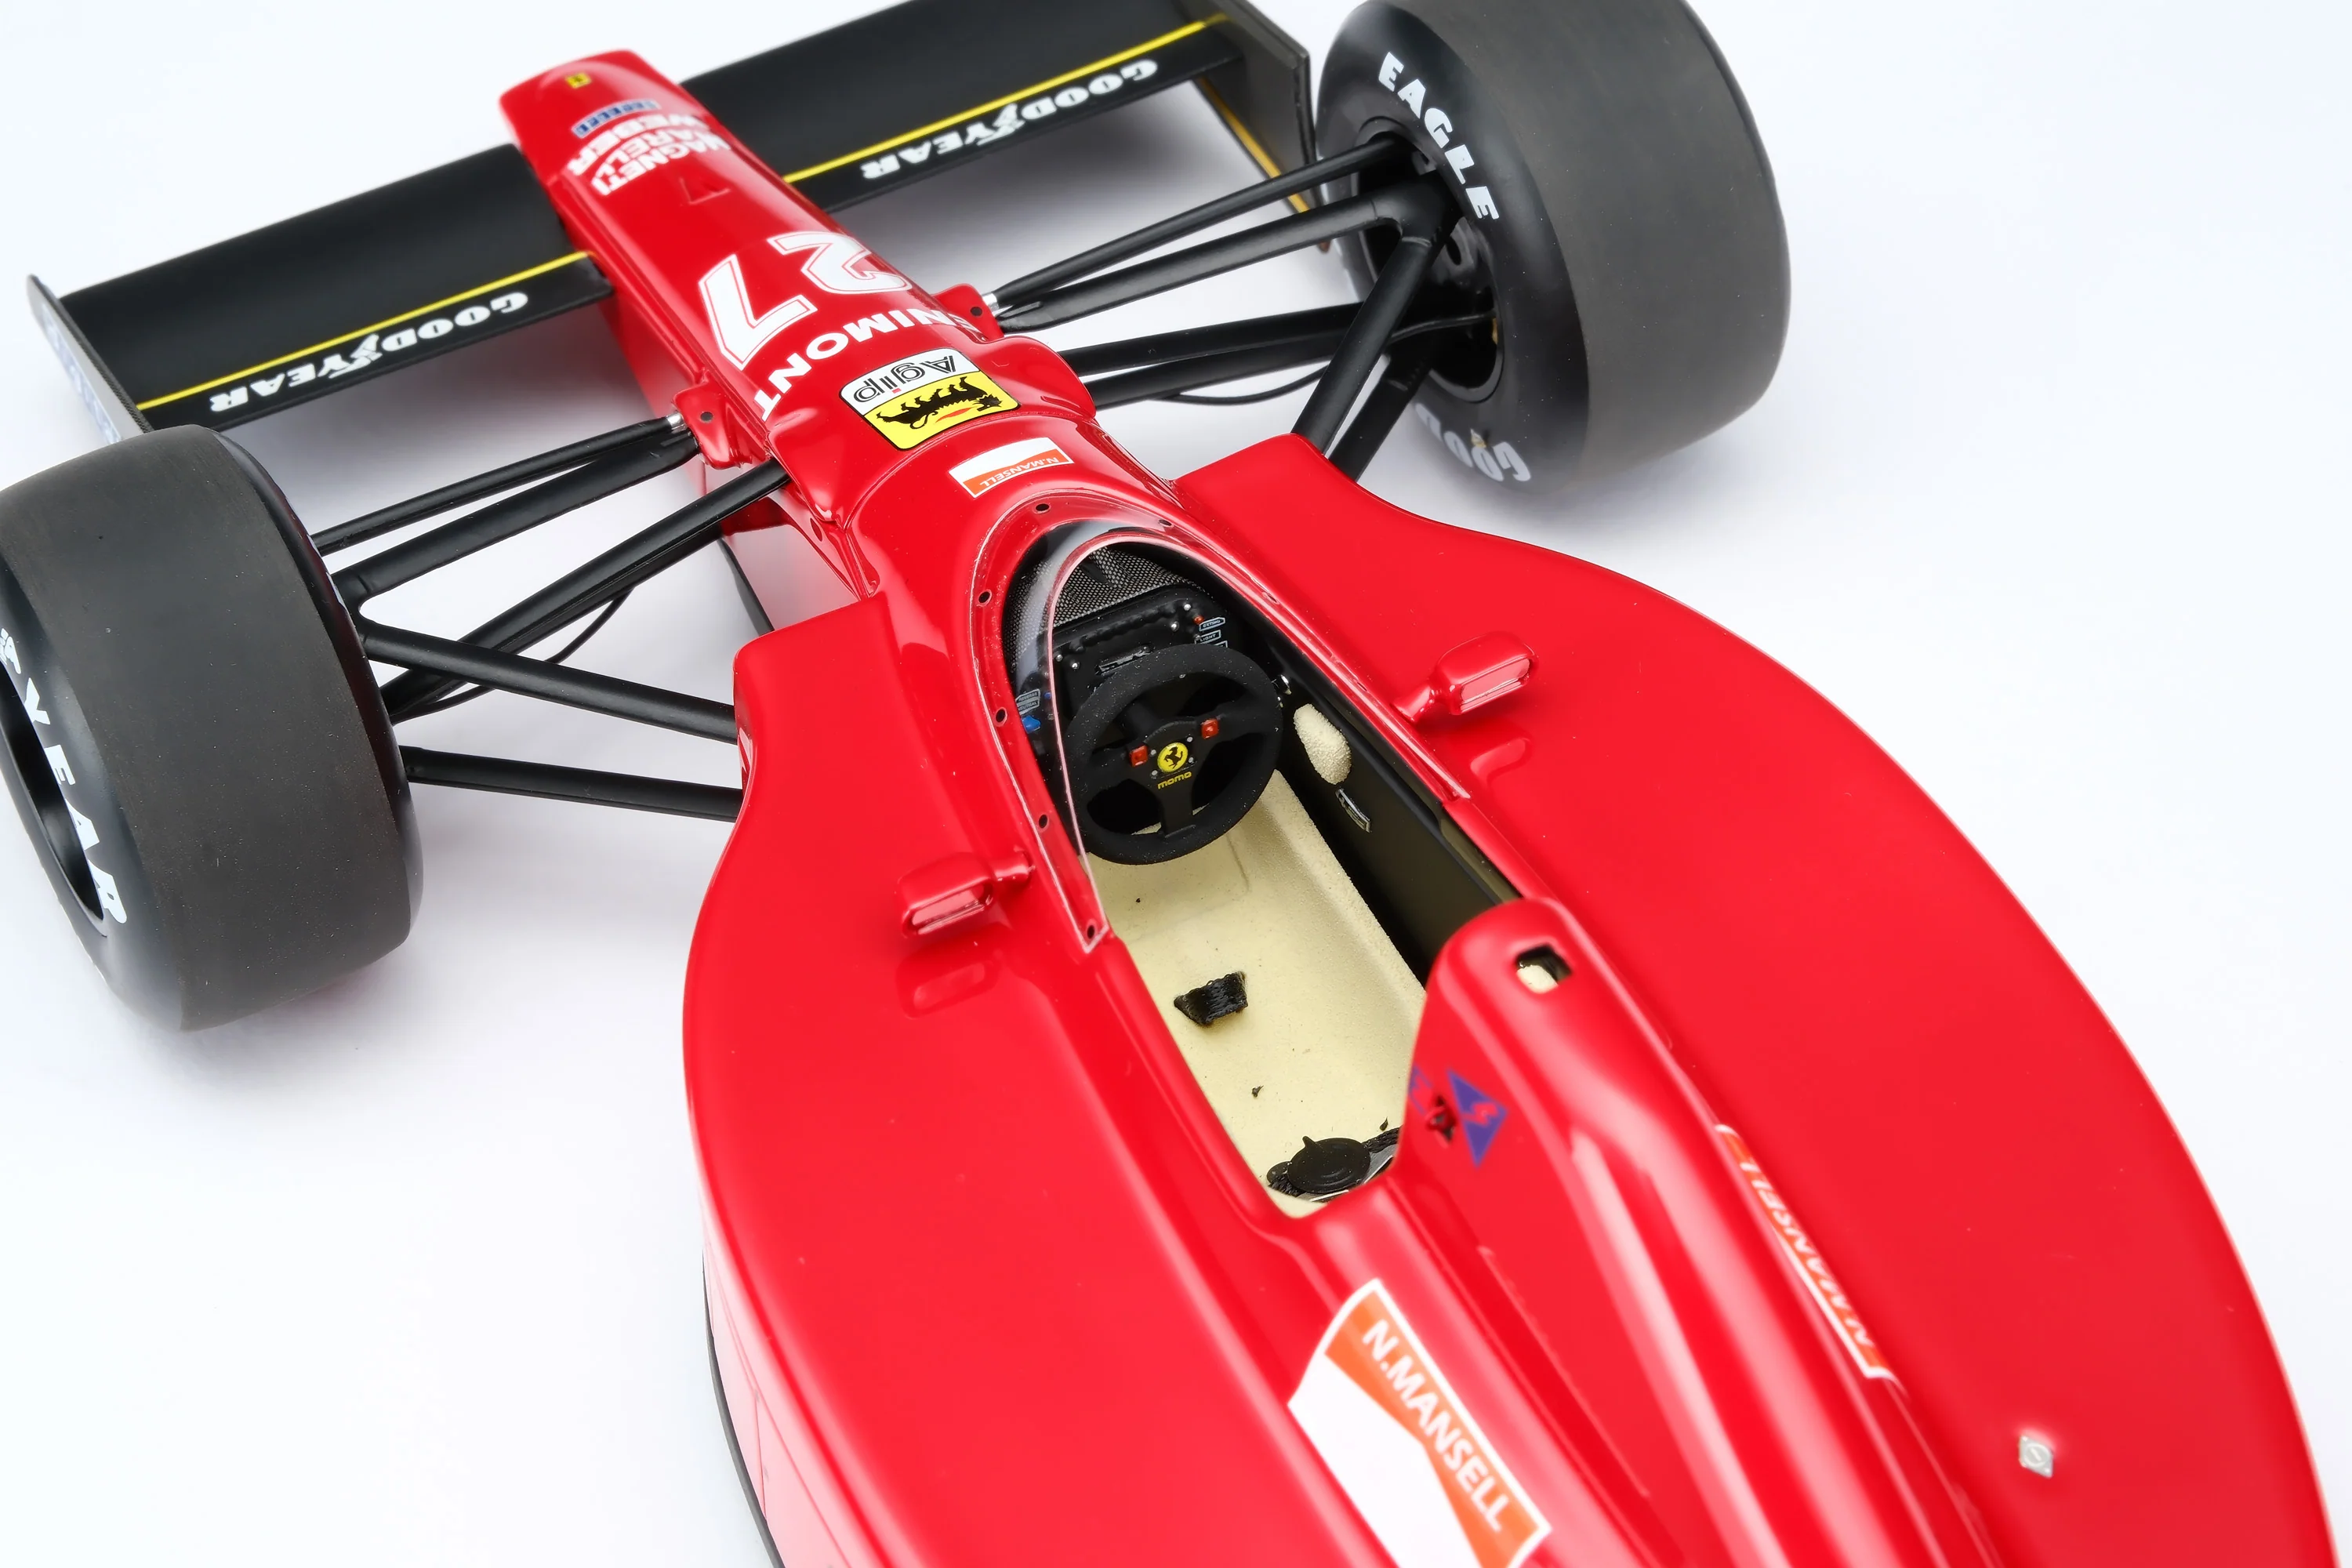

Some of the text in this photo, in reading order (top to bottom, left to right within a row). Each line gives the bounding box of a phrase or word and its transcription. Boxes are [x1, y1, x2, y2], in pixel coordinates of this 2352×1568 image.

[860, 59, 1159, 180] GOODYEAR
[1377, 51, 1500, 220] EAGLE
[209, 292, 528, 412] GOODYEAR
[698, 230, 913, 371] 27
[854, 355, 956, 403] Agip
[979, 456, 1060, 487] N.MANSELL
[1200, 633, 1216, 642] LIGHT
[1157, 771, 1192, 789] momo
[1362, 1318, 1510, 1534] N.MANSELL
